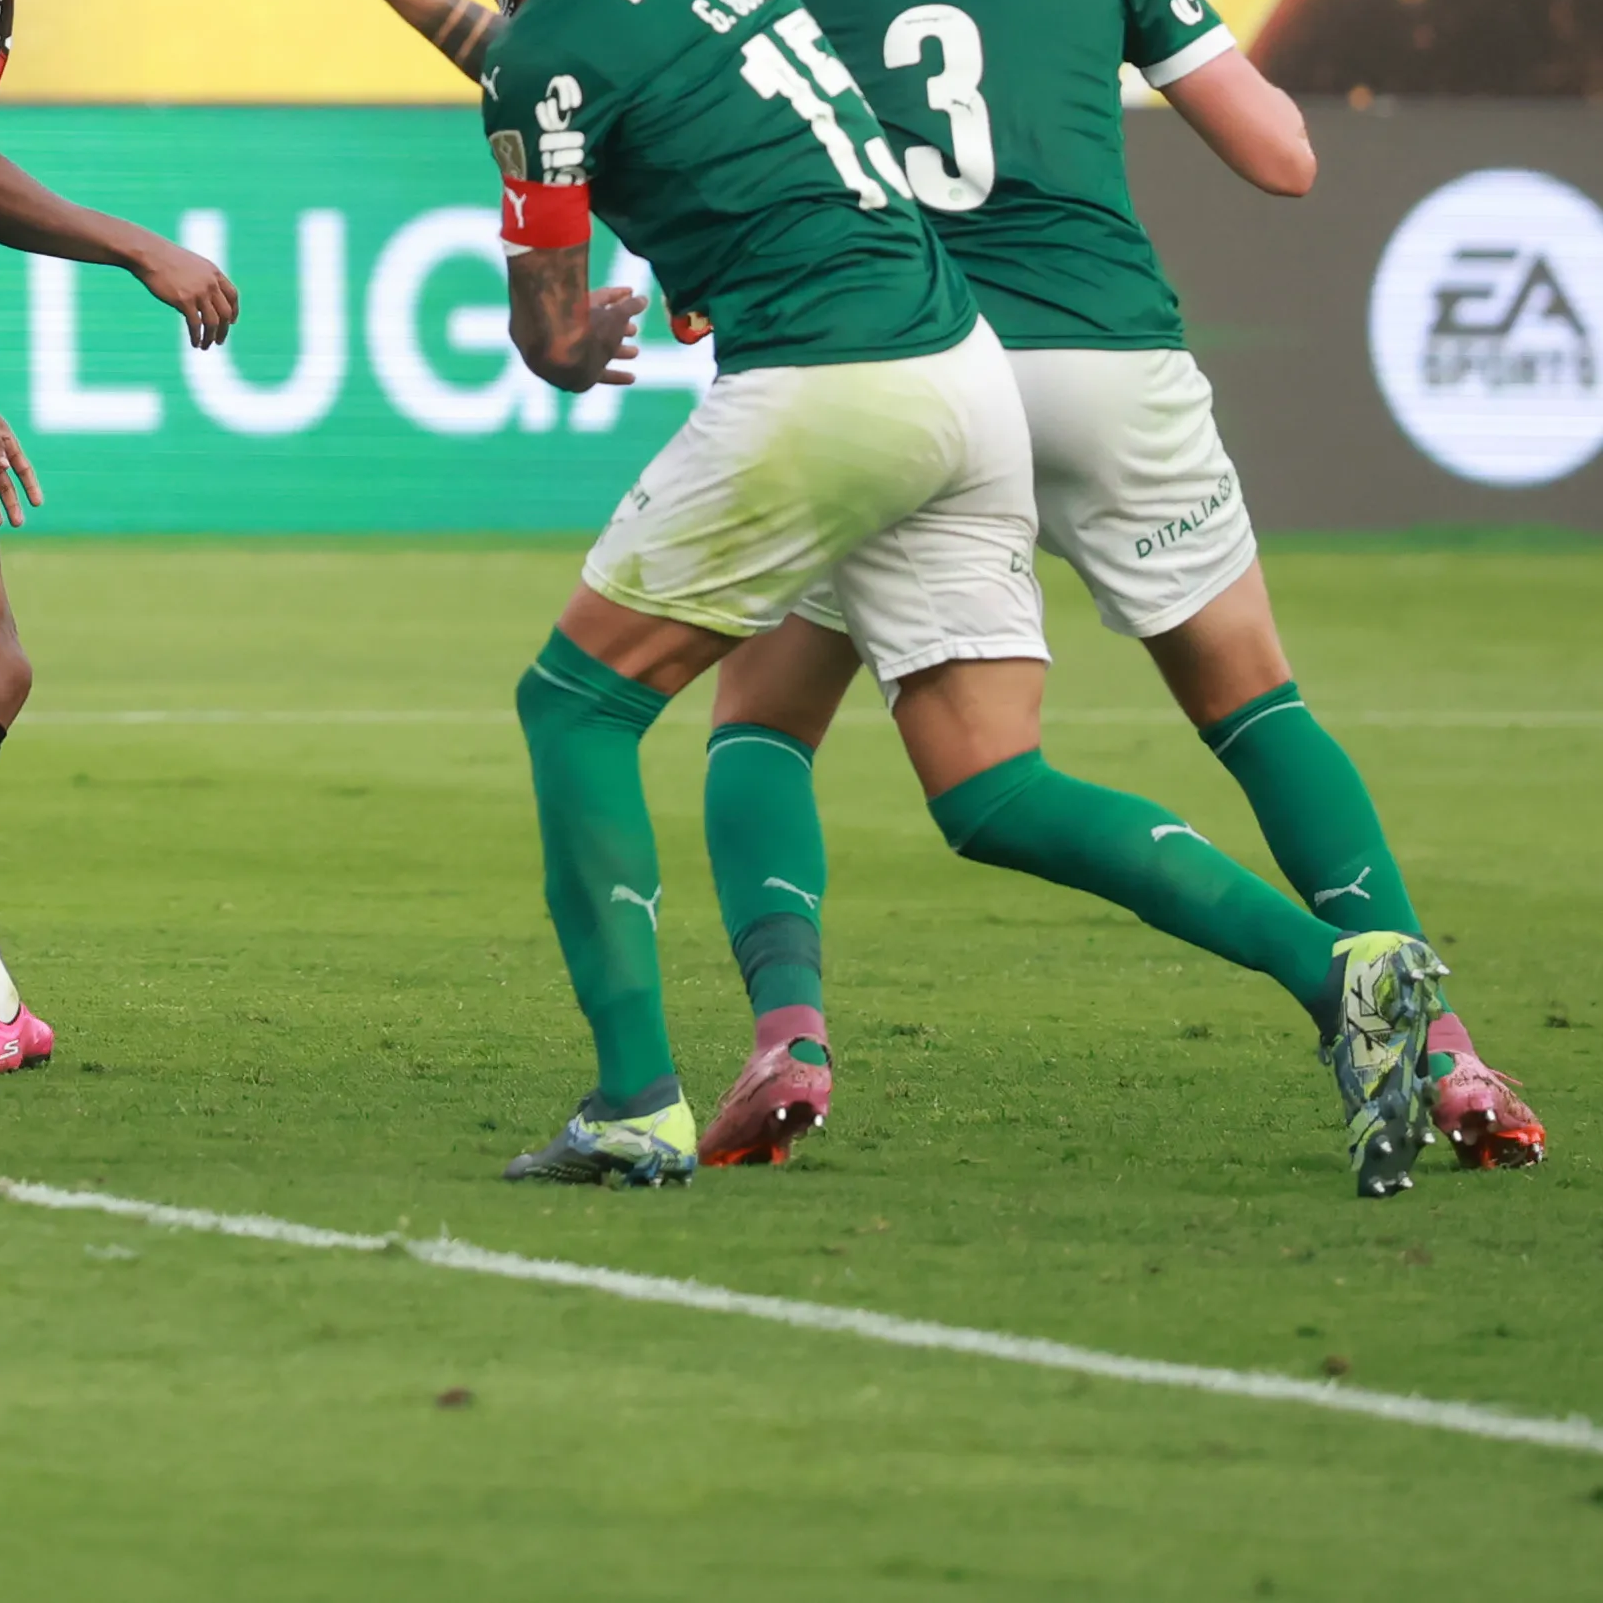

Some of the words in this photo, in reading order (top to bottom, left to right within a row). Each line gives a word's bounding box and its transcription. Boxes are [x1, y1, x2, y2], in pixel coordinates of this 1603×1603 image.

[740, 8, 913, 211] 15
[883, 3, 996, 212] 3
[1432, 247, 1587, 336] EA
[1135, 496, 1219, 559] D'ITALIA
